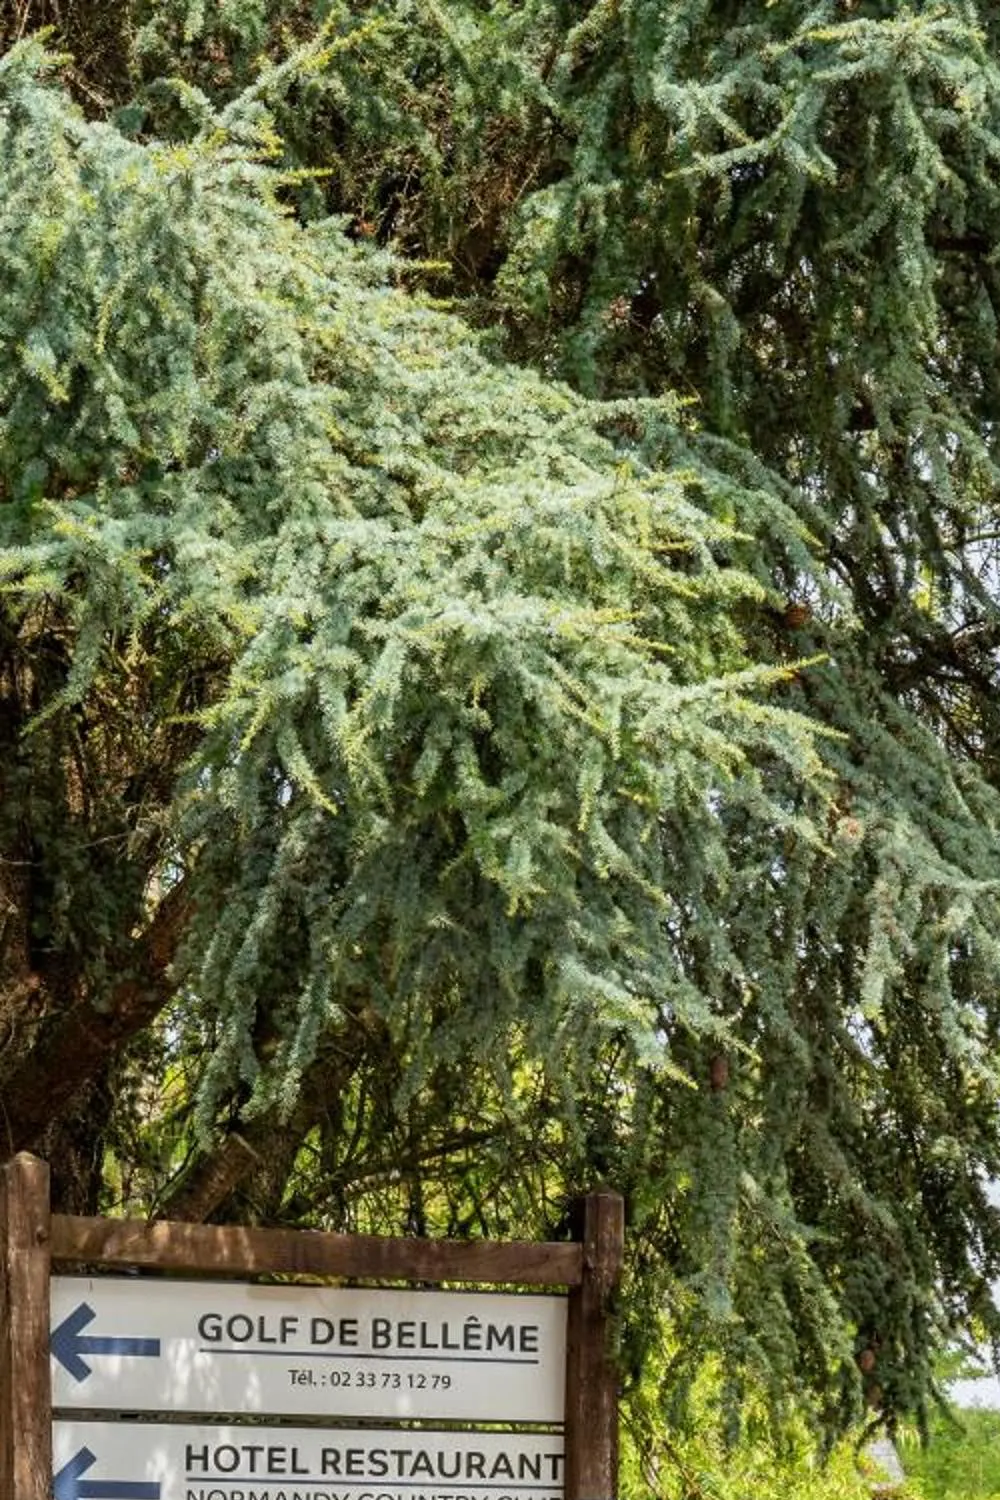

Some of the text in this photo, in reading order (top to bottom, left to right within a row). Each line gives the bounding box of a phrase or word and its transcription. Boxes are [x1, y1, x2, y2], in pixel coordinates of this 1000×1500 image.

[198, 1313, 539, 1352] GOLF DE BELLÊME
[330, 1371, 350, 1387] 02
[355, 1372, 376, 1387] 33
[381, 1373, 401, 1389] 73
[407, 1373, 427, 1389] 12
[431, 1374, 451, 1389] 79
[185, 1444, 566, 1480] HOTEL RESTAURANT
